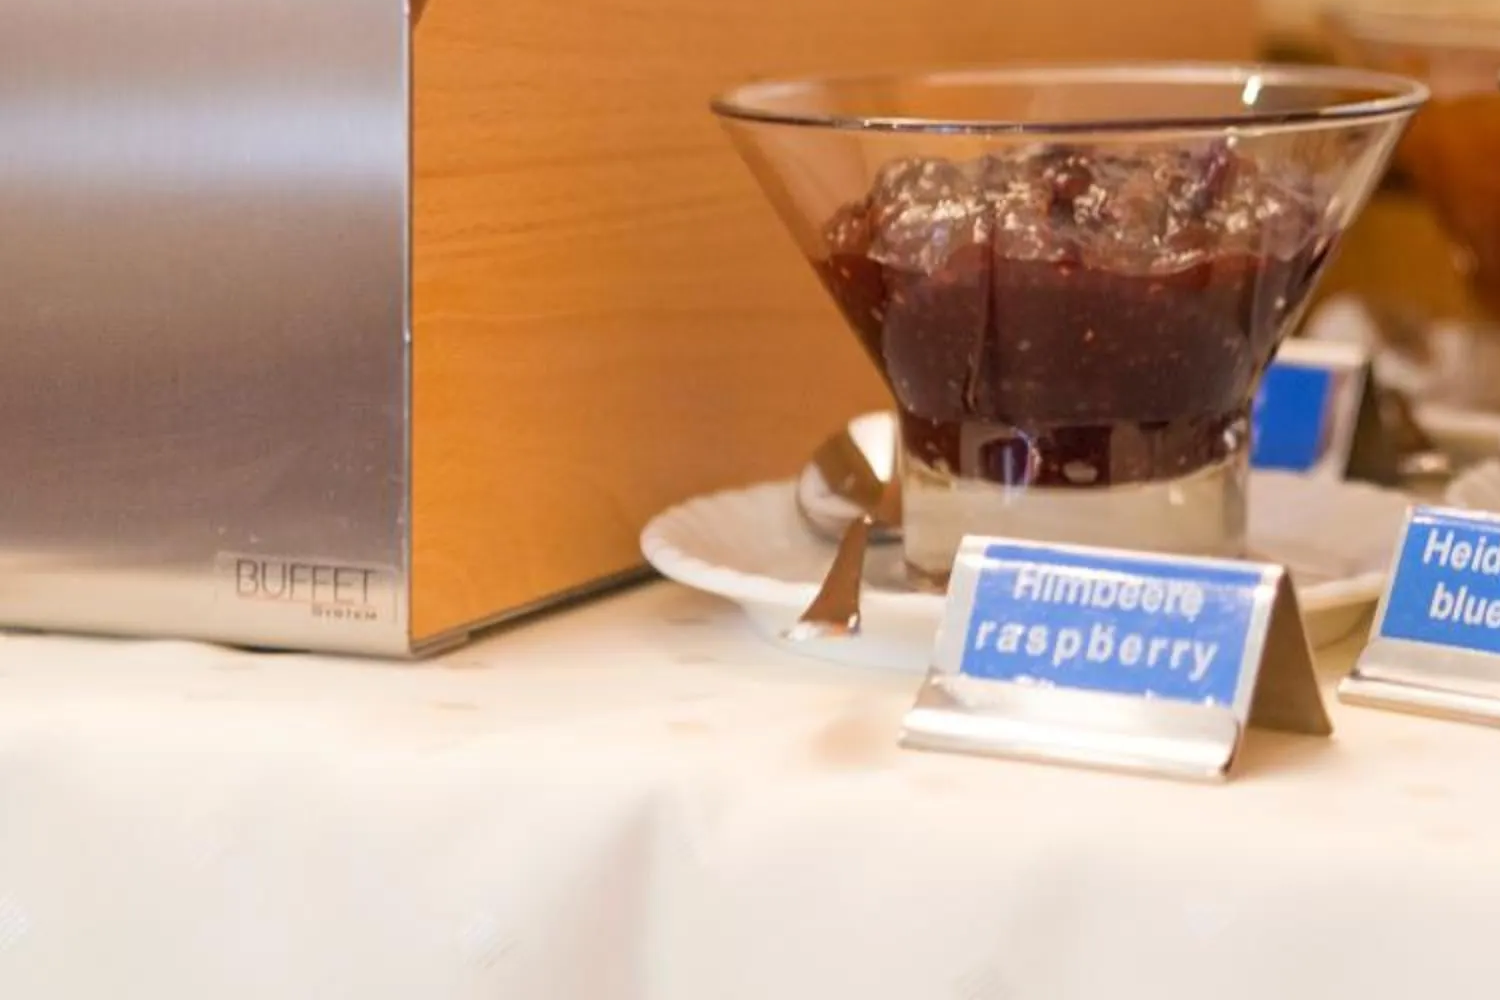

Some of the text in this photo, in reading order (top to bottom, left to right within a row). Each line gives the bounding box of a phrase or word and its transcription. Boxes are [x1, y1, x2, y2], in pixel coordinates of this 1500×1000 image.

[235, 558, 378, 604] BUFFET
[1012, 565, 1206, 617] Himbeere
[974, 620, 1219, 682] raspberry
